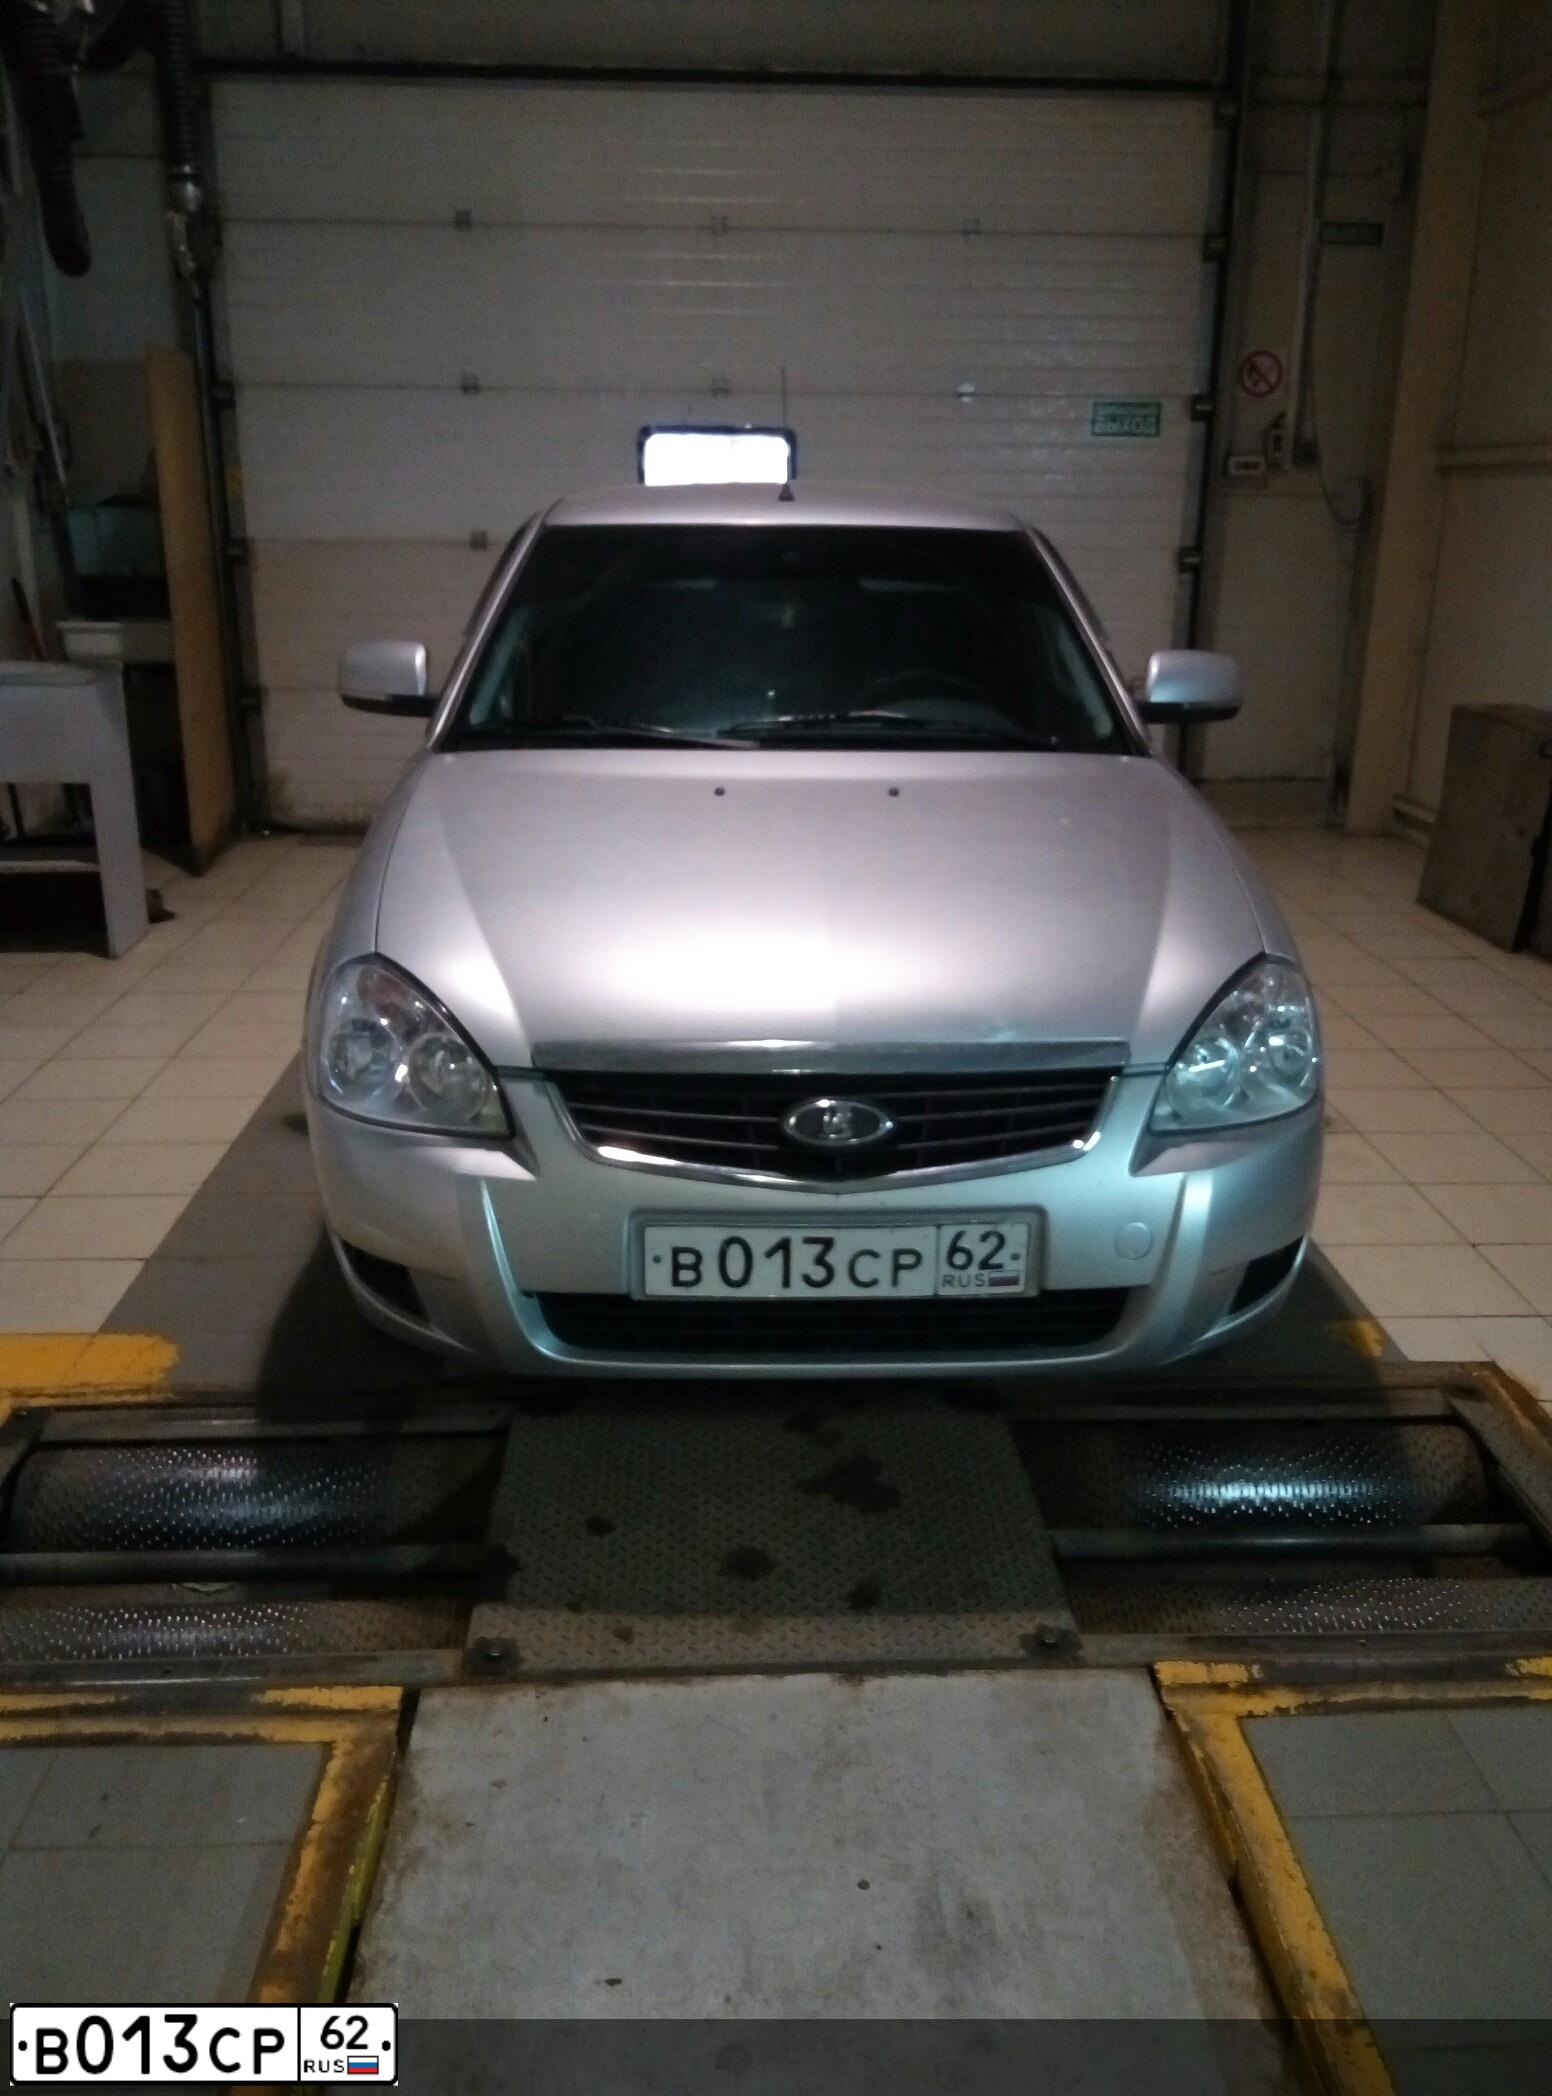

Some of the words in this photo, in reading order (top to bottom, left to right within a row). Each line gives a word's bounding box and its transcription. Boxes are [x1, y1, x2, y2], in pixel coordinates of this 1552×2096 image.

[671, 1235, 923, 1289] В013СР
[946, 1229, 1006, 1272] 62
[942, 1273, 986, 1288] RUS
